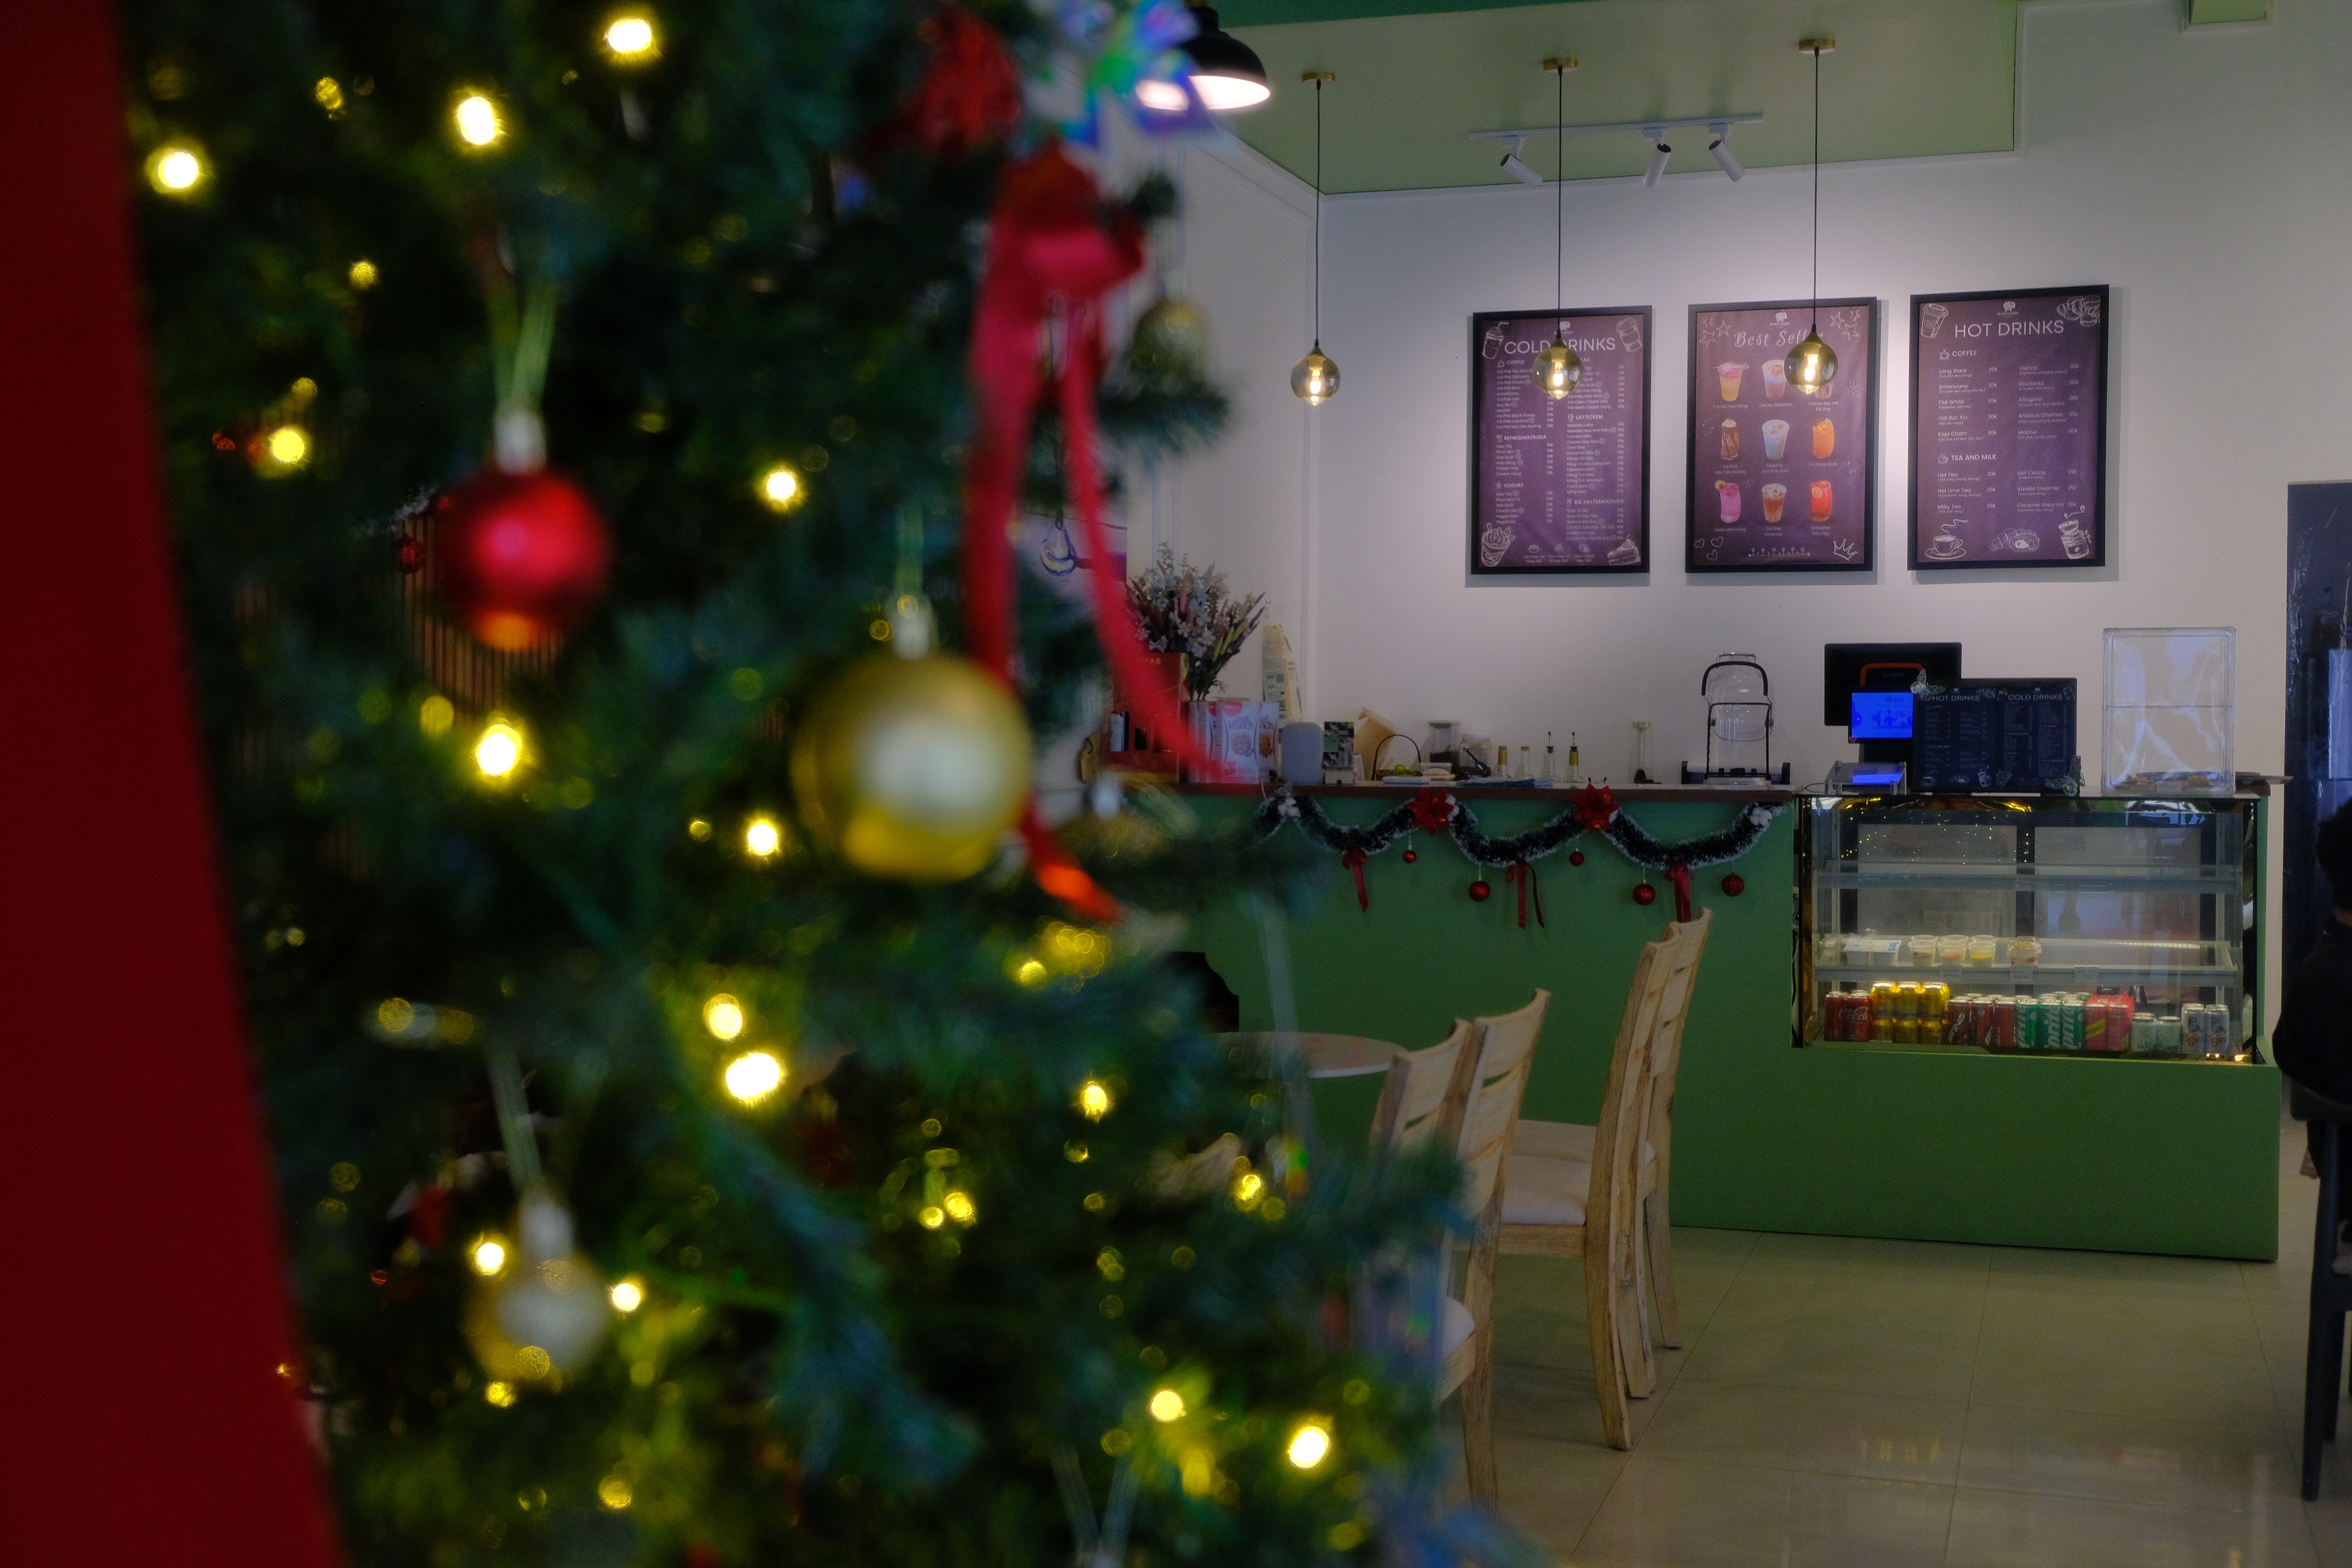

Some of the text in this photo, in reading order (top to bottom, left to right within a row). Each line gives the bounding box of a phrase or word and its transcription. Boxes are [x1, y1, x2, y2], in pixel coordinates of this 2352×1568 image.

[1955, 320, 2064, 338] HOT DRINKS
[1505, 337, 1615, 354] COLD RINKS
[1734, 329, 1823, 348] Best Sellr
